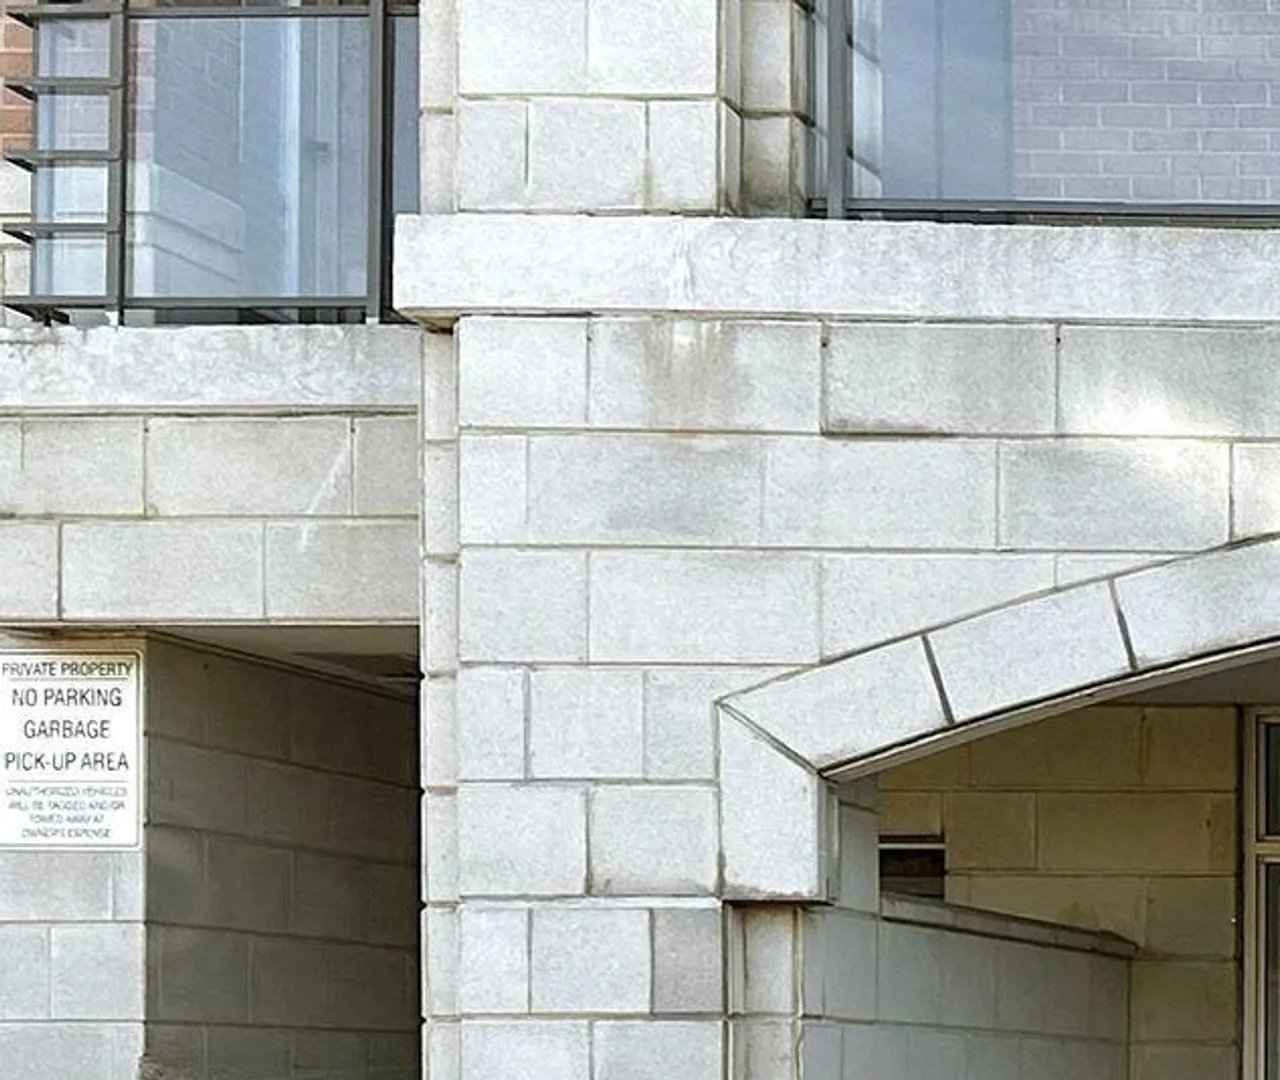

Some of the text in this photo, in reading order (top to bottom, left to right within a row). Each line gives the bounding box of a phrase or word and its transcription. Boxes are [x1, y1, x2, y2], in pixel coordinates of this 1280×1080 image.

[2, 661, 133, 676] PRIVATE PROPERTY
[12, 687, 122, 706] NO PARKING
[24, 719, 110, 739] GARBAGE
[5, 752, 129, 771] PICK-UP AREA
